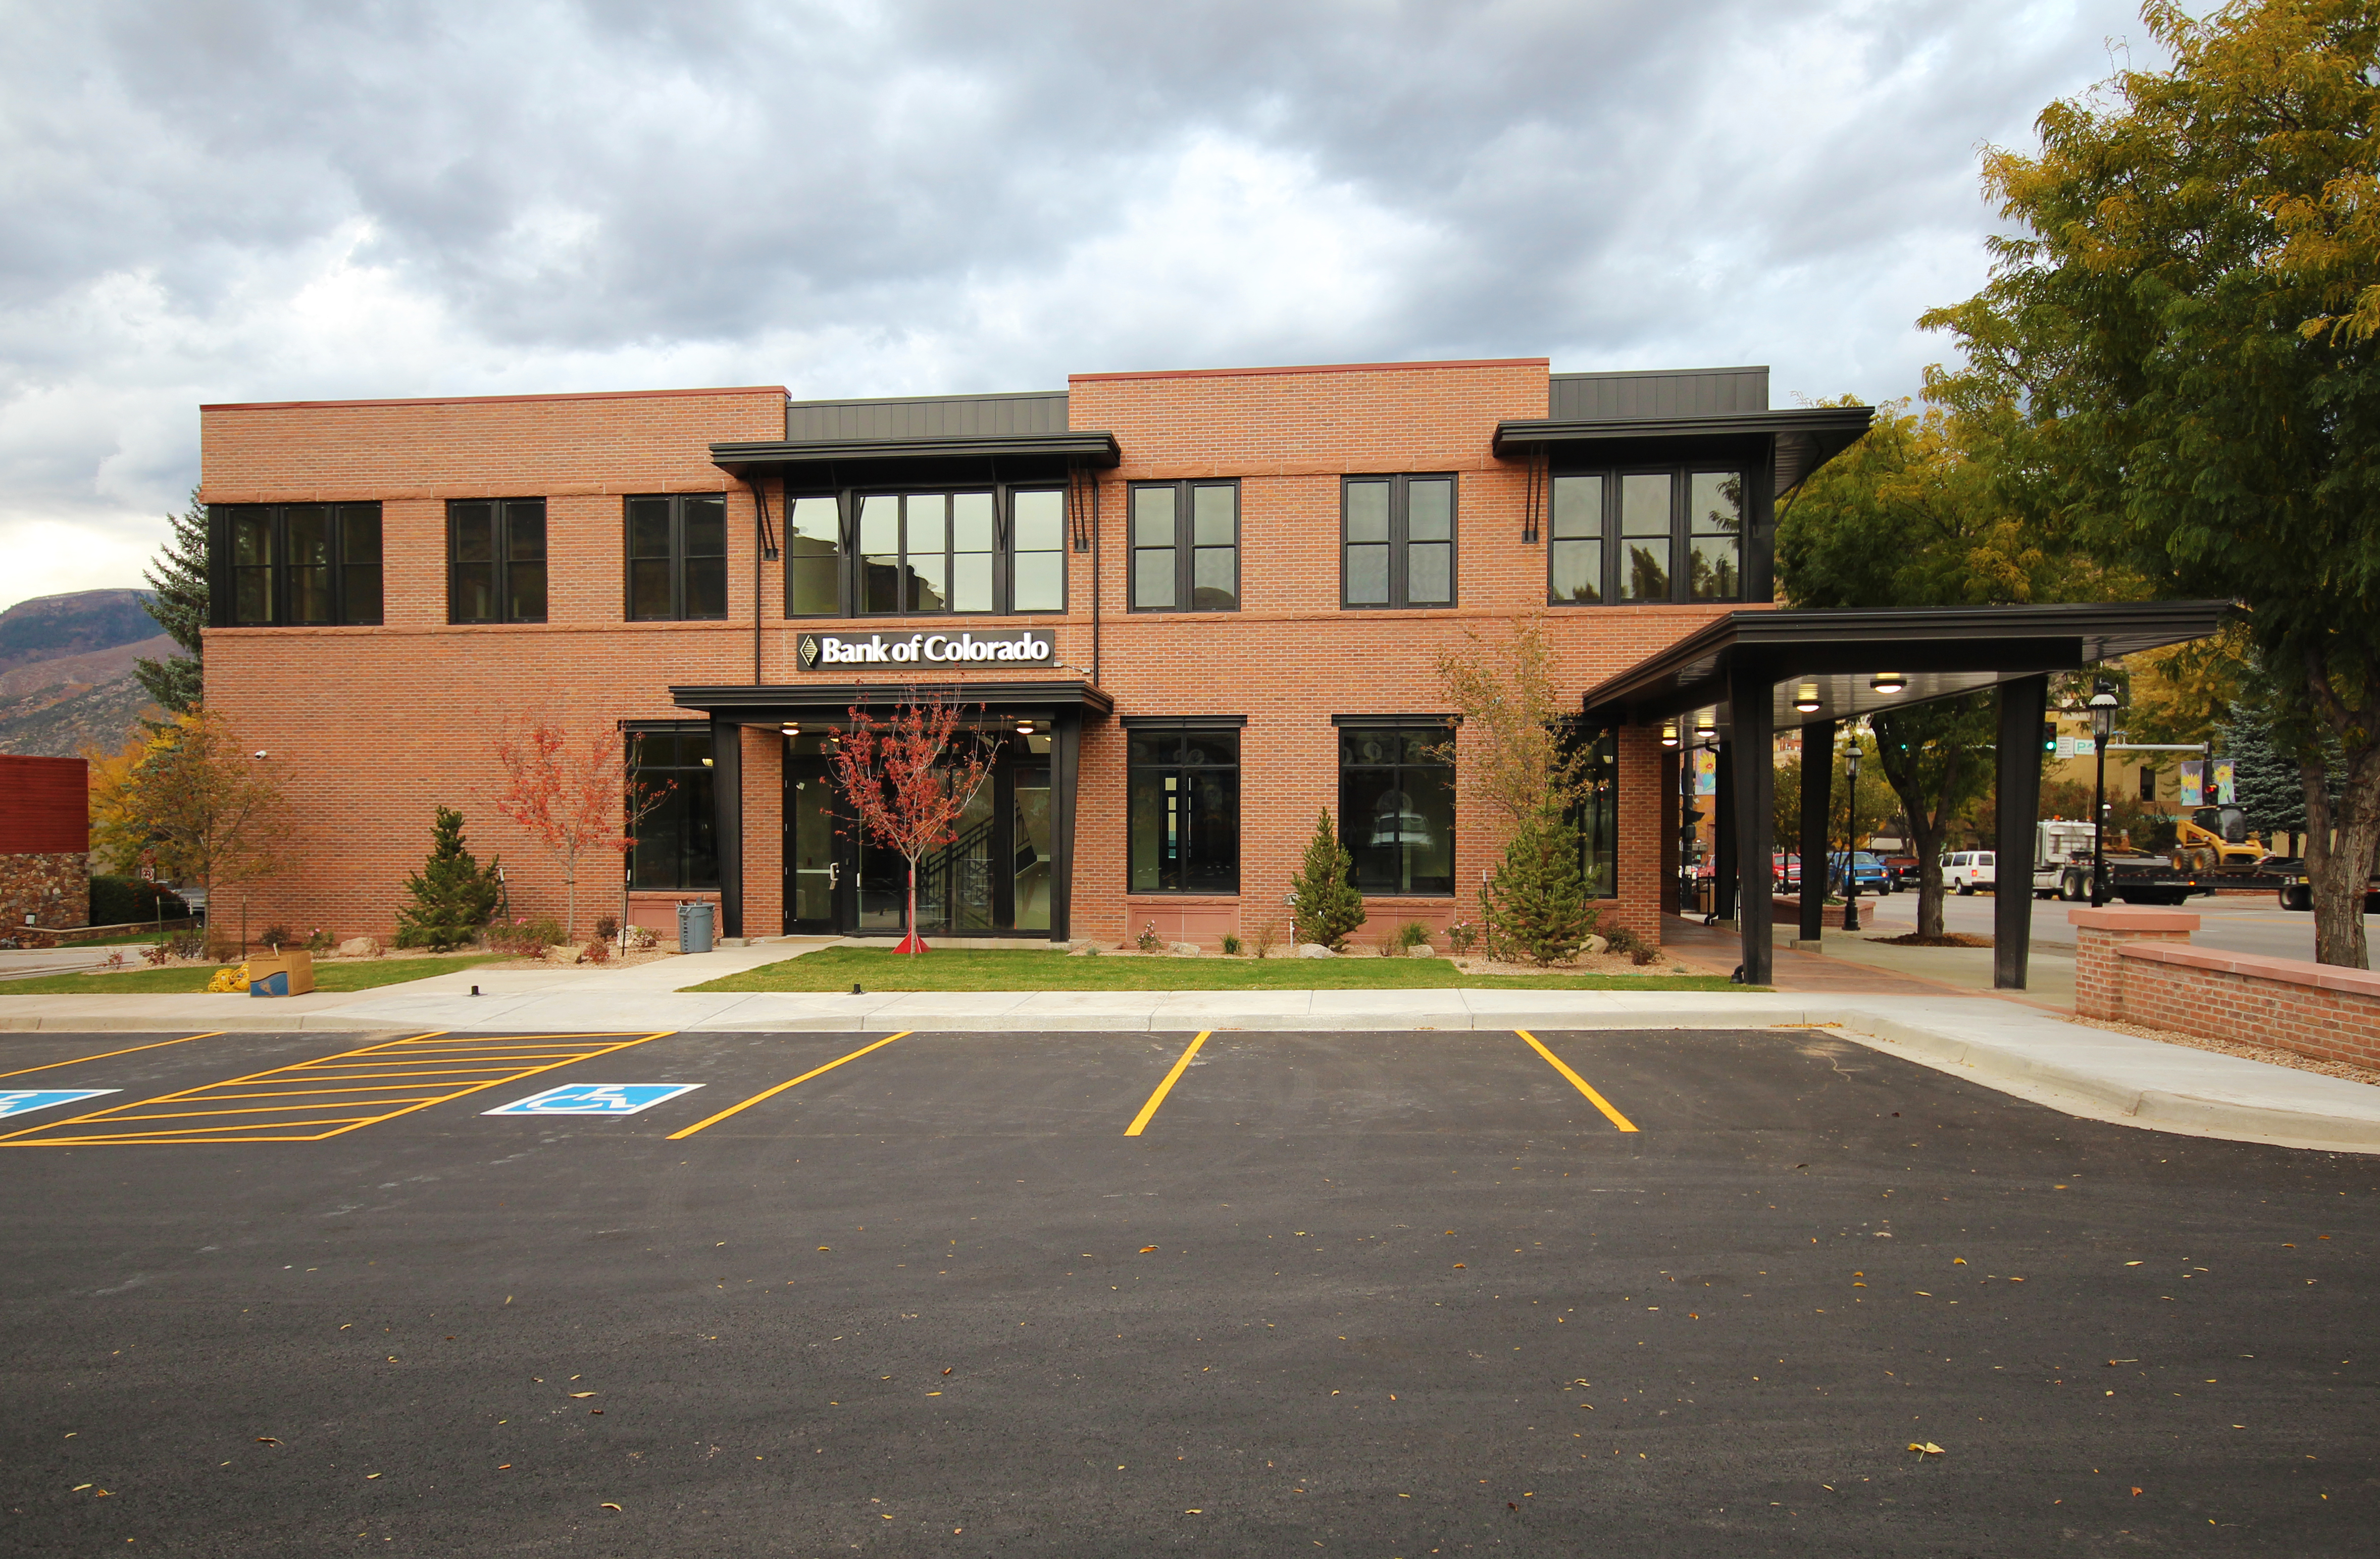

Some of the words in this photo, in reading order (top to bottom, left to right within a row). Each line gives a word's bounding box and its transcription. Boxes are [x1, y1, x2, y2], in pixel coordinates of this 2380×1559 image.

[822, 635, 890, 663] Bank
[891, 634, 923, 662] of
[924, 632, 1050, 662] Colorado
[2077, 742, 2086, 752] P
